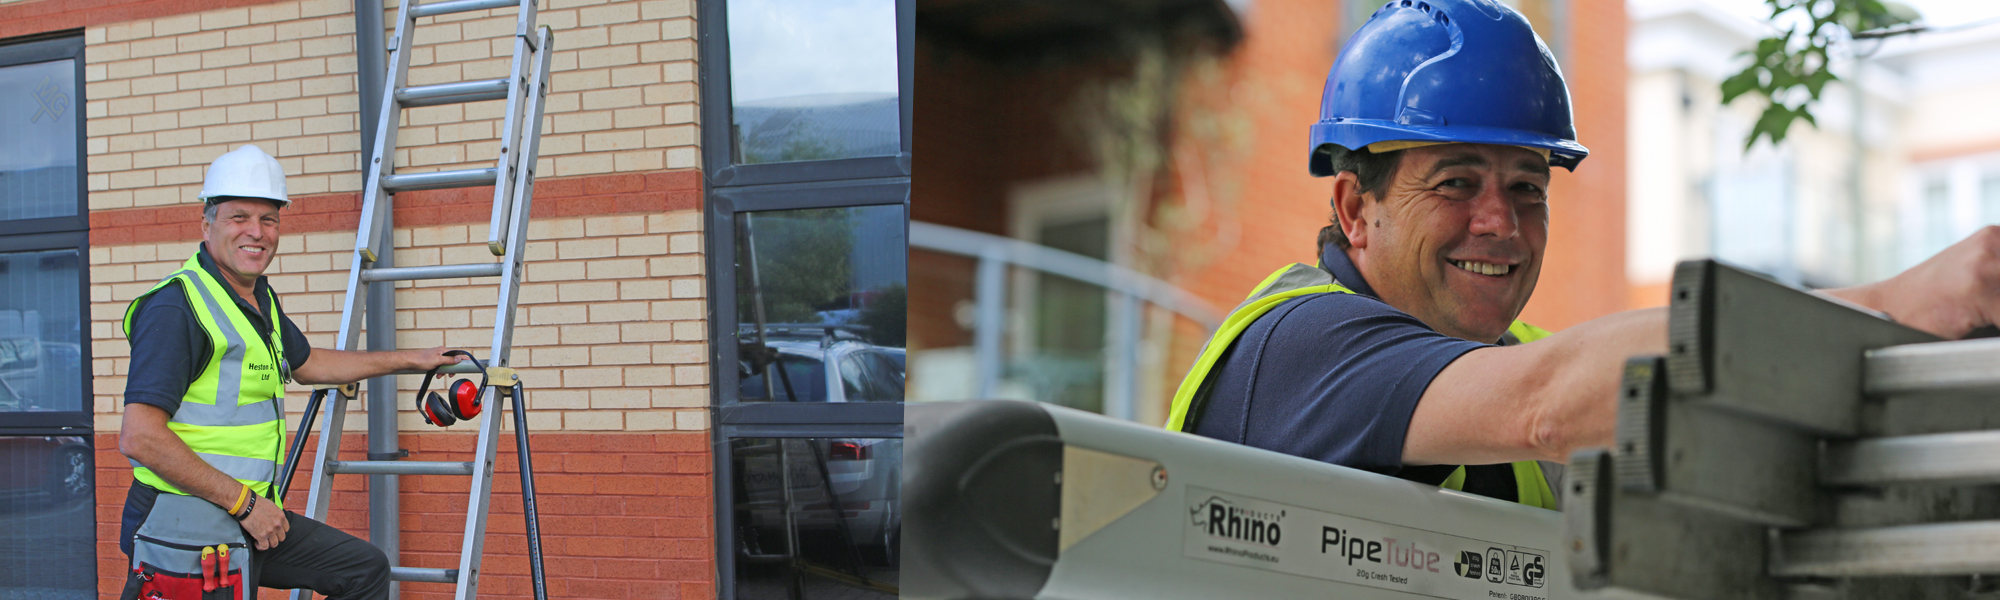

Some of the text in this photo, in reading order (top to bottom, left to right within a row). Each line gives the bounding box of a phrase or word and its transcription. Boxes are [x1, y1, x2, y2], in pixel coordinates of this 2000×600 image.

[1209, 502, 1281, 546] Rhino
[1321, 525, 1440, 574] PipeTube
[1356, 569, 1408, 584] 20g Crash Tested
